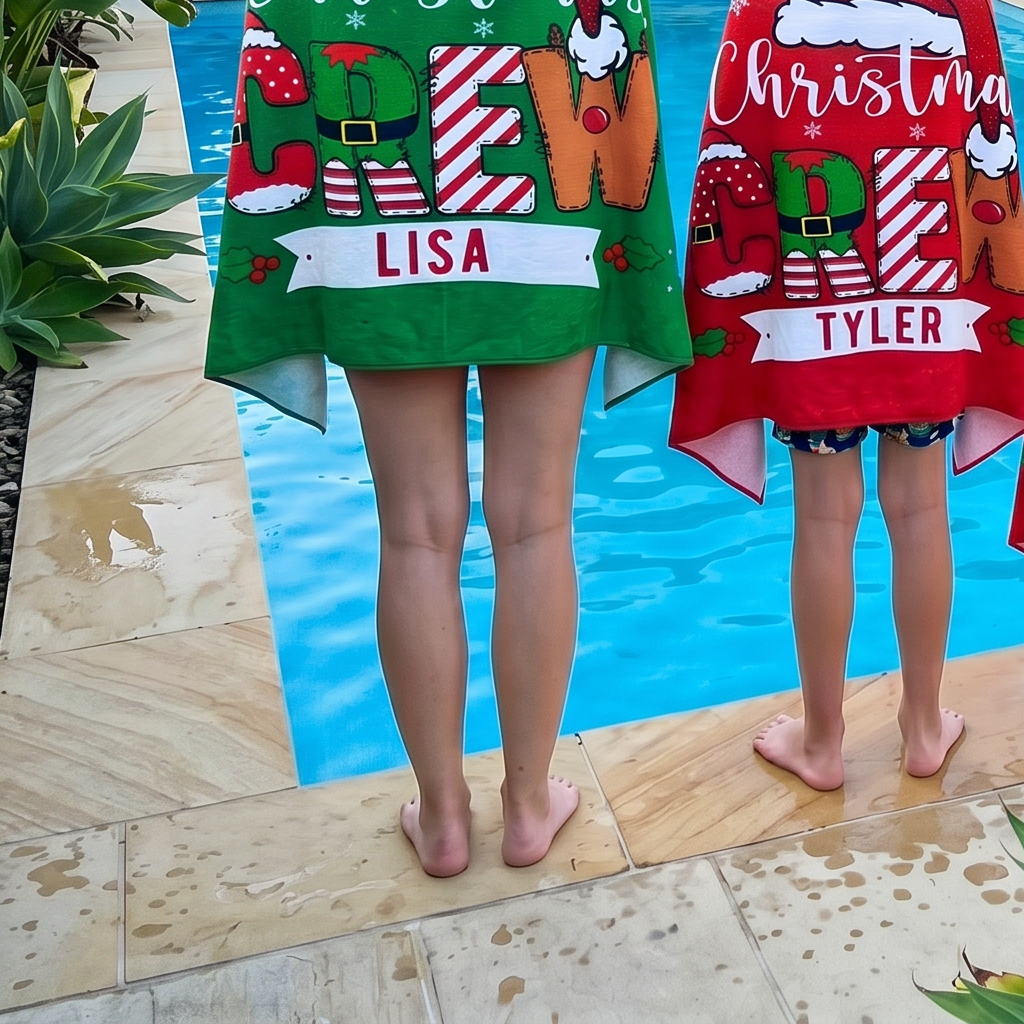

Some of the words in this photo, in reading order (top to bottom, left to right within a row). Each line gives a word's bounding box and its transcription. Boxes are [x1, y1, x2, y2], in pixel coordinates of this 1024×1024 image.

[709, 37, 1013, 126] Christma
[226, 26, 662, 216] CREW
[376, 227, 490, 278] LISA
[816, 305, 942, 351] TYLER
